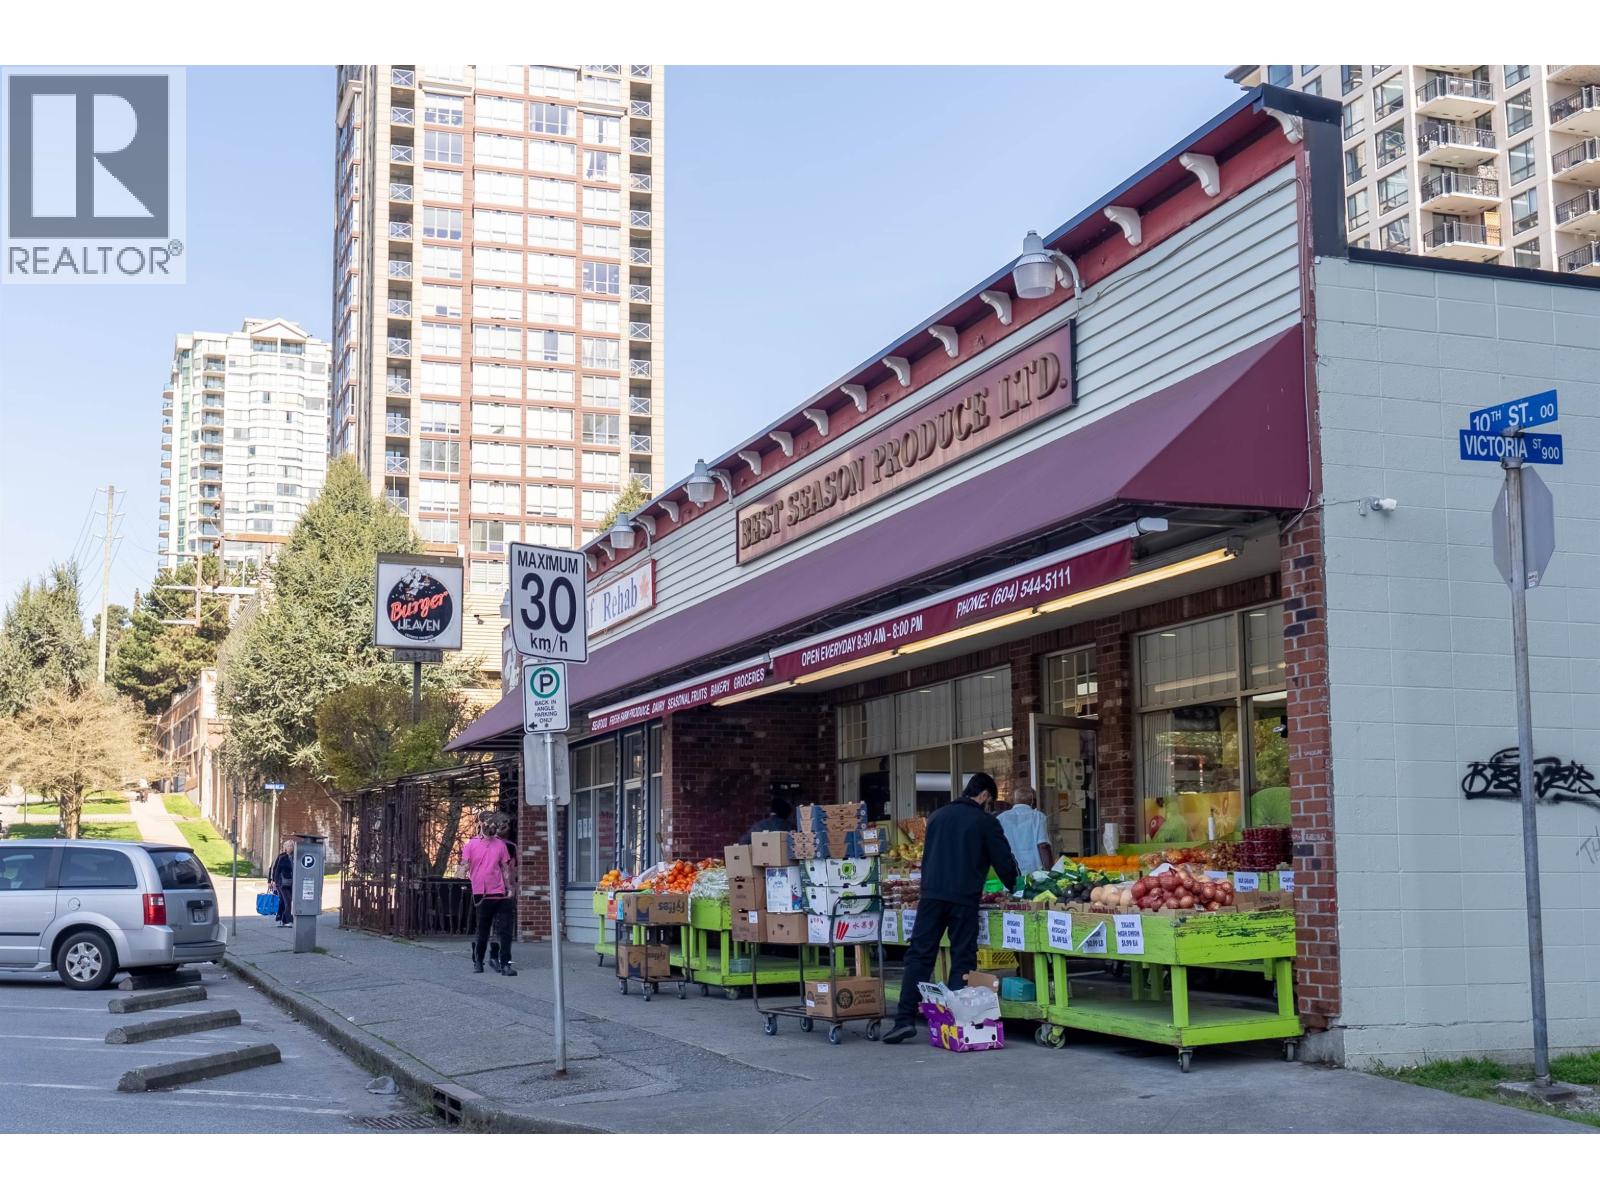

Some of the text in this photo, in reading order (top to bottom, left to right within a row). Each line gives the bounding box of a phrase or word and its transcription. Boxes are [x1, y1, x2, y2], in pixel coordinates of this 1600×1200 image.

[1508, 402, 1533, 426] ST.
[1540, 403, 1554, 418] 00
[740, 352, 1068, 549] BEST SEASON PRODUCE LTD.
[1464, 434, 1560, 460] VICTORIA ST 900
[517, 550, 578, 575] MAXIMUM
[390, 591, 449, 622] Burger
[520, 572, 577, 634] 30
[603, 577, 638, 622] Rehab
[956, 565, 1071, 619] PHONE: (604) 544-5111
[397, 618, 440, 632] HEAVEN
[530, 633, 568, 653] km/h
[801, 648, 820, 667] OPEN
[820, 635, 857, 661] EVERYDAY
[857, 631, 872, 650] 9:30
[872, 627, 886, 645] AM
[892, 619, 909, 639] 8:00
[910, 615, 923, 634] PM
[539, 674, 554, 692] P
[667, 692, 690, 710] SEASONAL
[691, 687, 708, 703] FRUITS
[710, 679, 730, 697] BAKERY
[733, 668, 765, 689] GROCERIES
